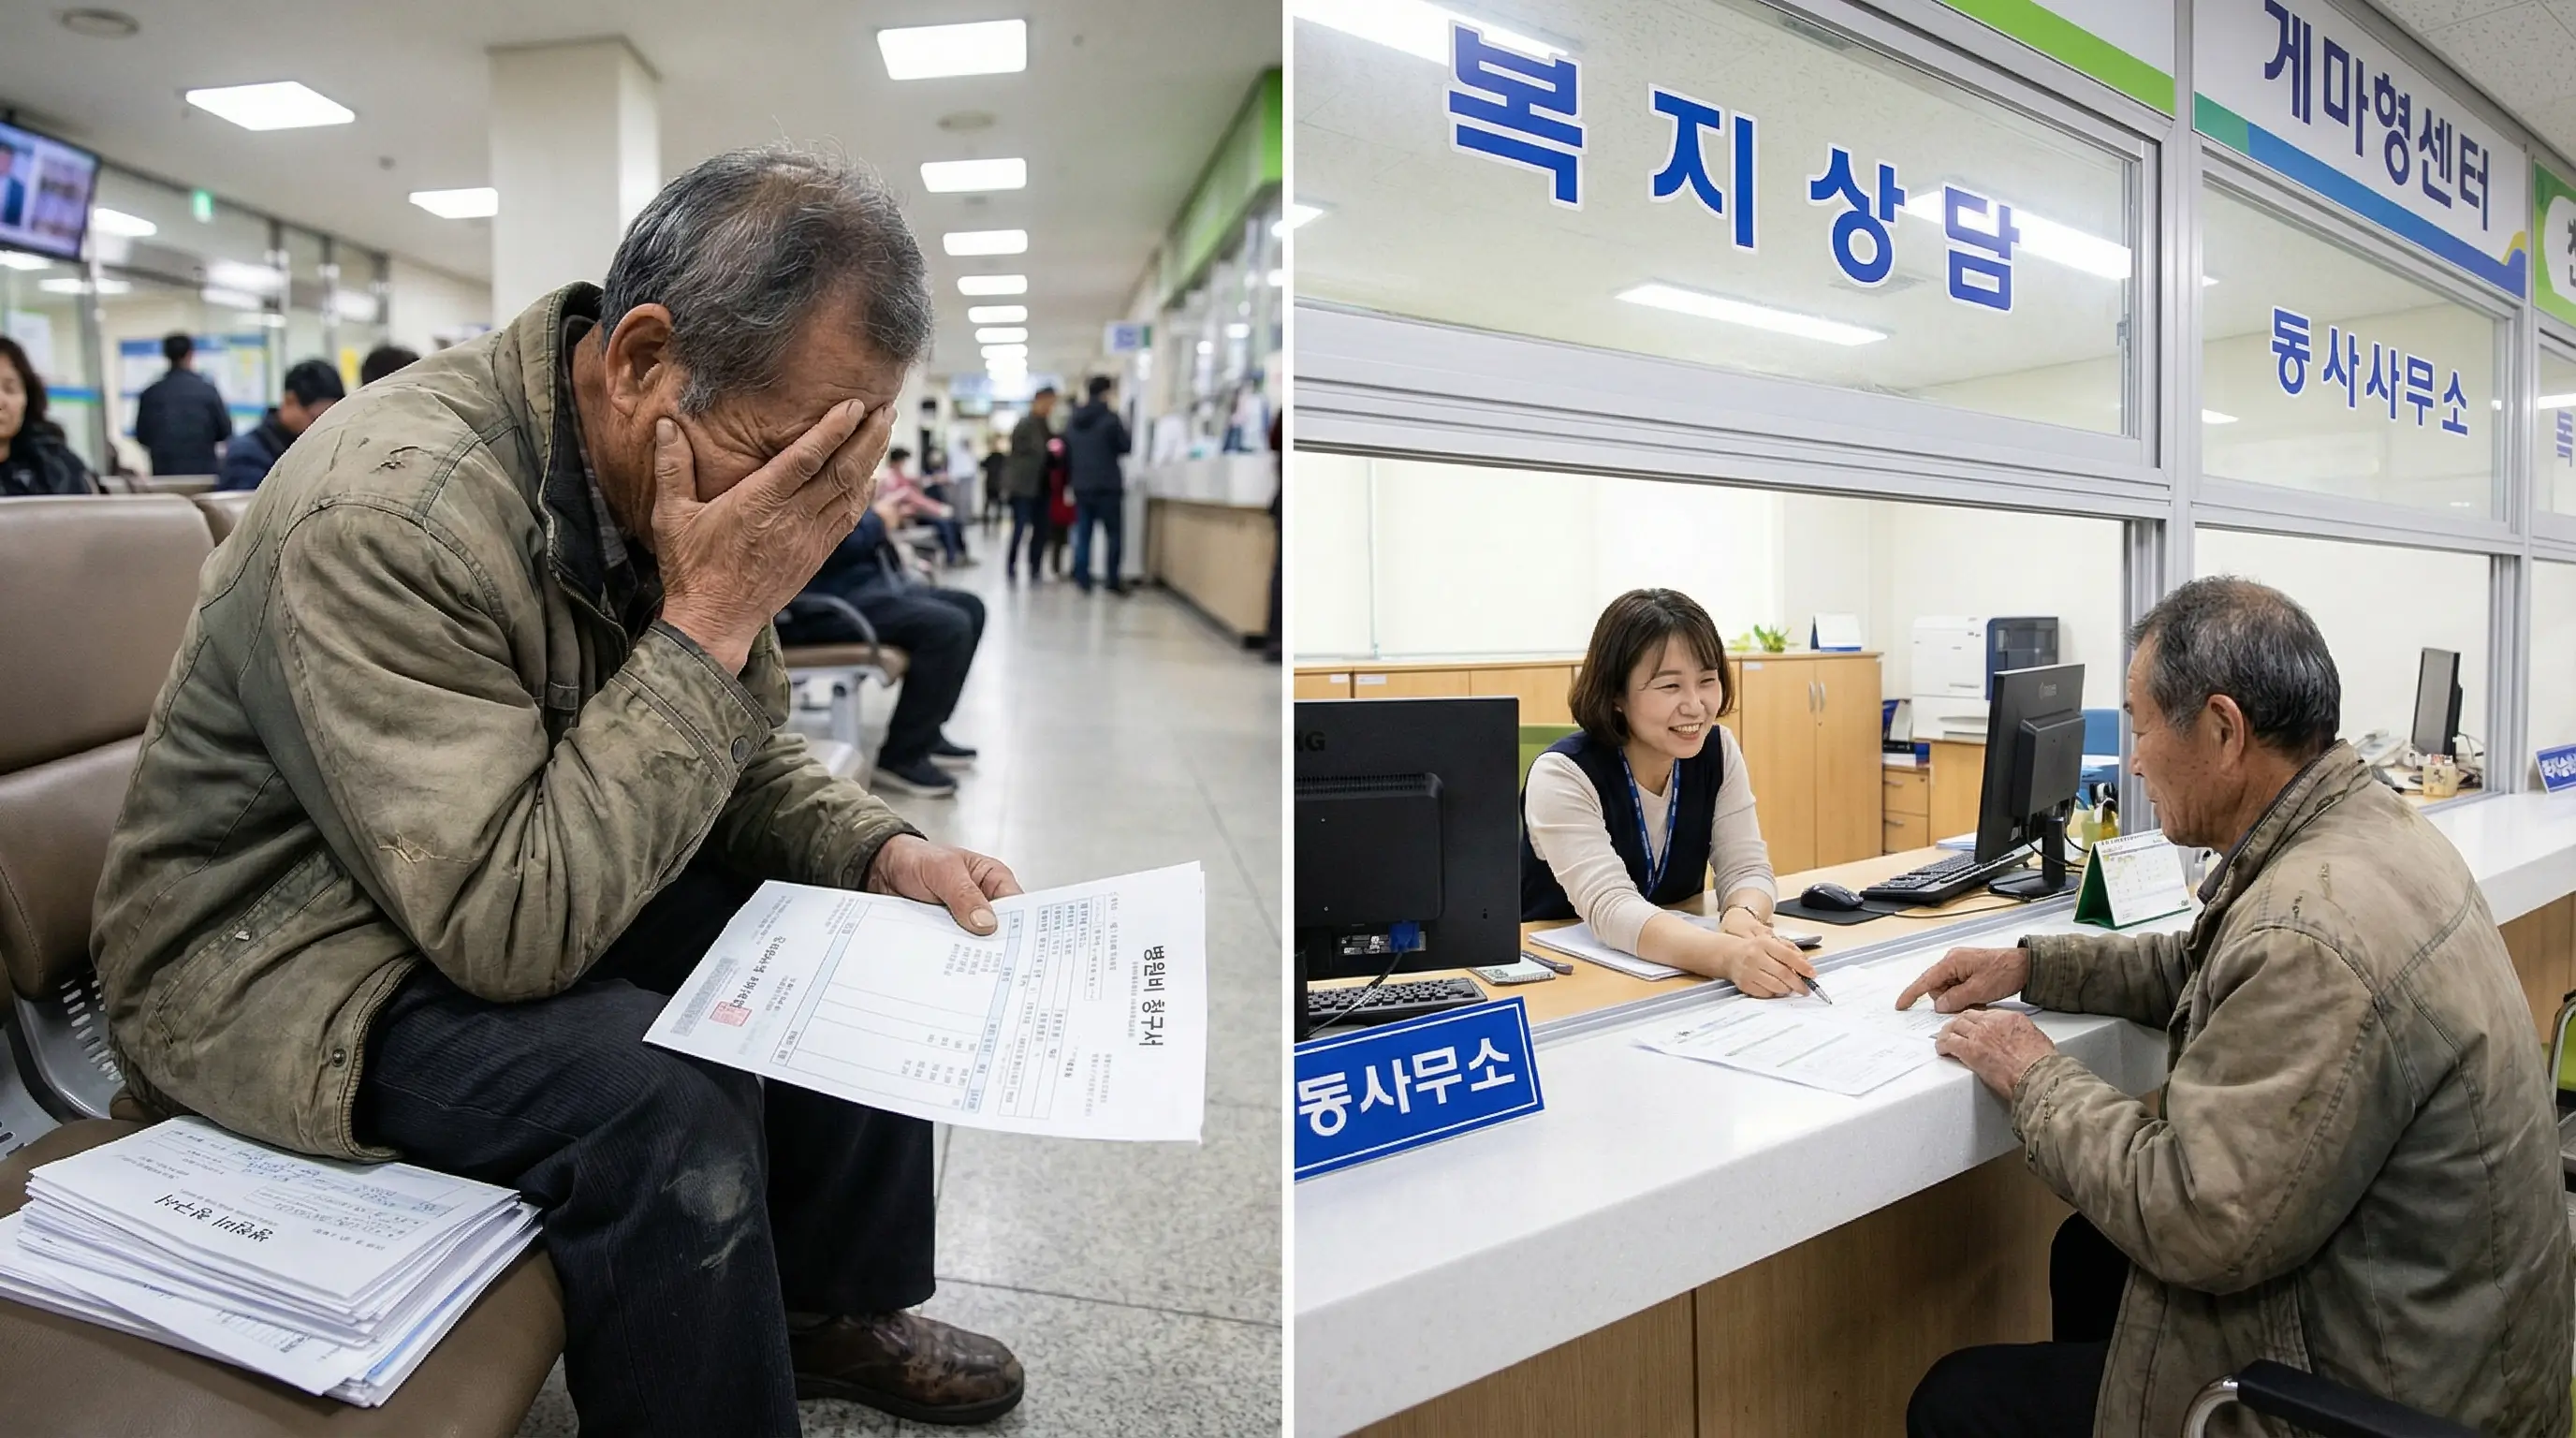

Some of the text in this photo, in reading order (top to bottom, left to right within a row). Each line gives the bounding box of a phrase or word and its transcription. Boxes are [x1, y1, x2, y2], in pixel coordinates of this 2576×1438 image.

[1447, 22, 2021, 313] 복지상담
[2263, 0, 2490, 231] 게마형센터
[2271, 307, 2469, 437] 동사사무소
[1138, 945, 1166, 1047] 병원비 청구서
[1298, 1036, 1516, 1137] 동사무소
